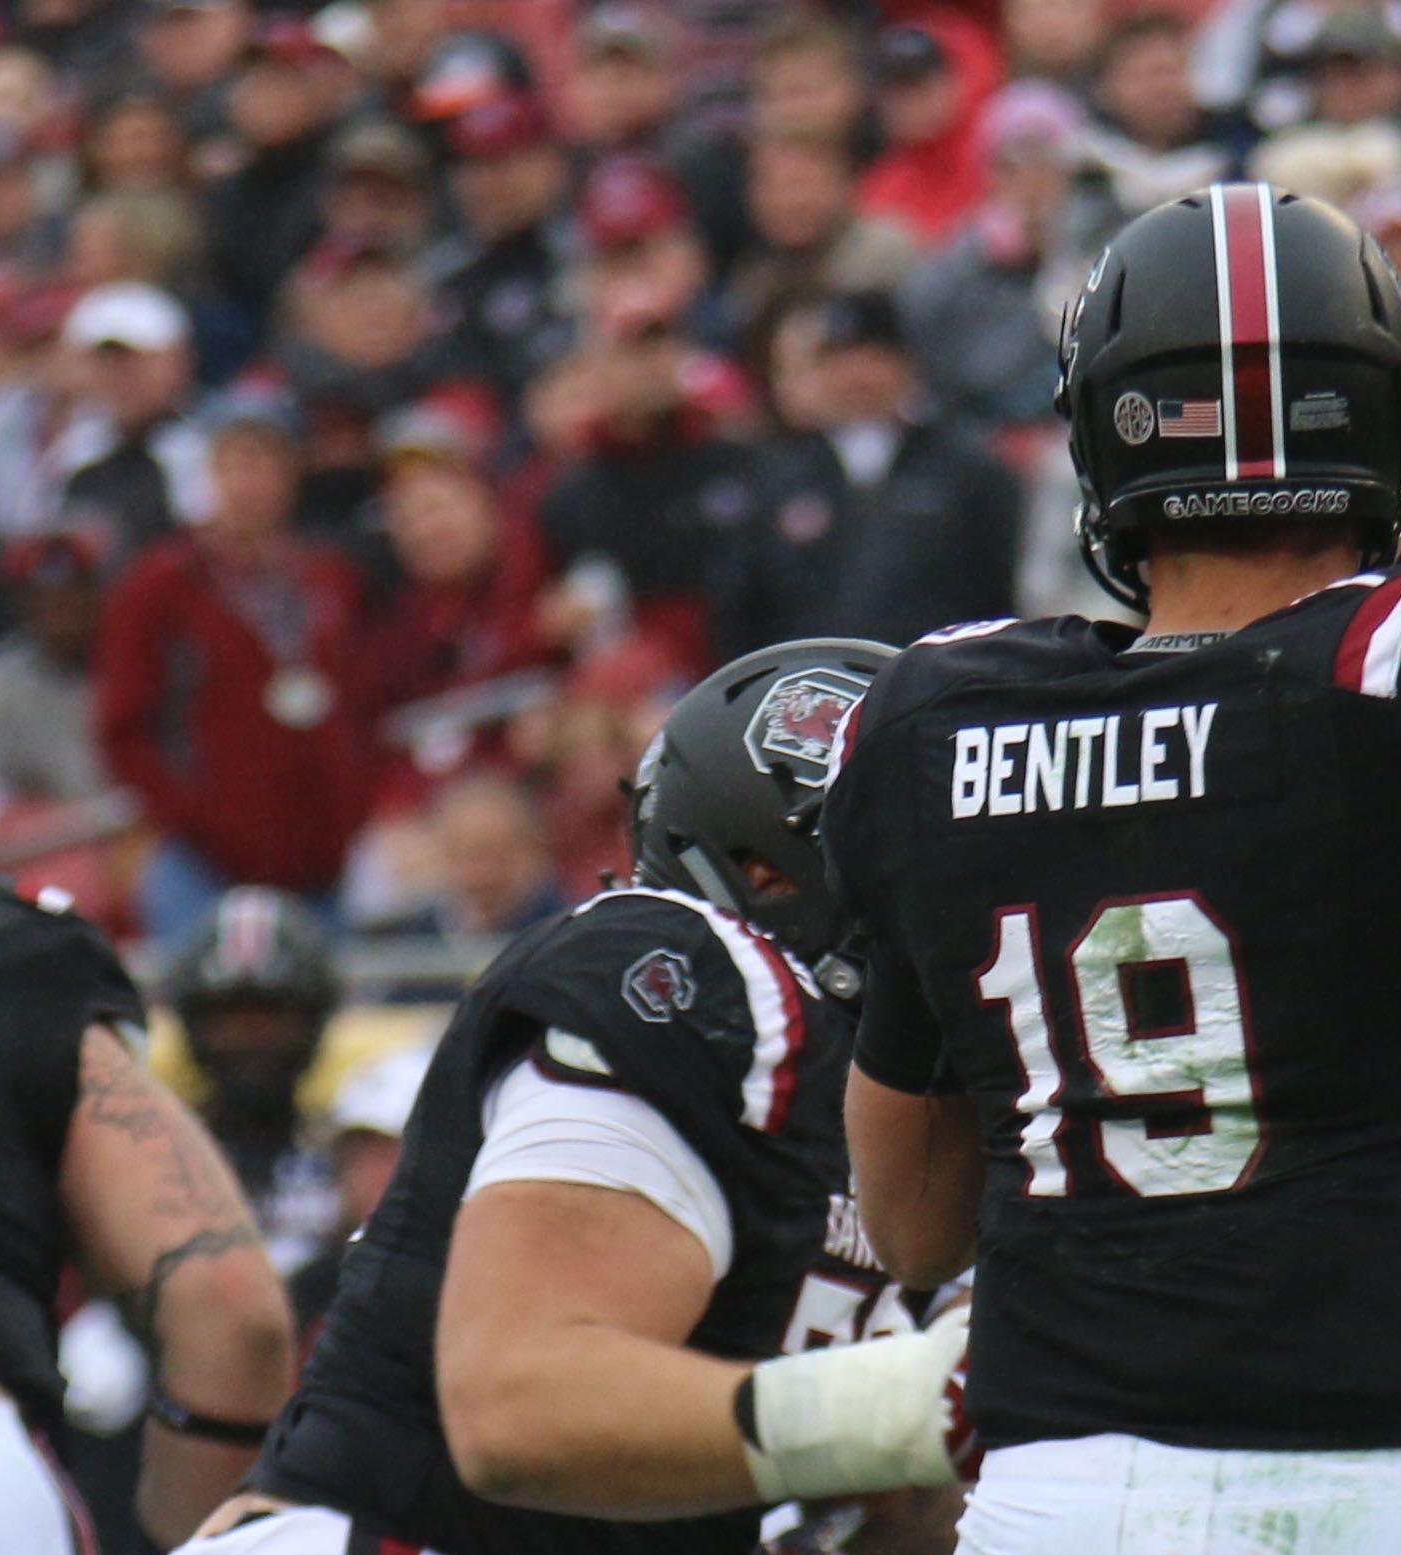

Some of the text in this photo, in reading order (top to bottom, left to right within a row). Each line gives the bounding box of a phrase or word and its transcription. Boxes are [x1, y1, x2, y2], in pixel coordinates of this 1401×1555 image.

[1163, 489, 1351, 519] GAMECOCKS
[1139, 632, 1237, 649] ARMO
[950, 703, 1218, 819] BENTLEY
[972, 889, 1270, 1198] 19
